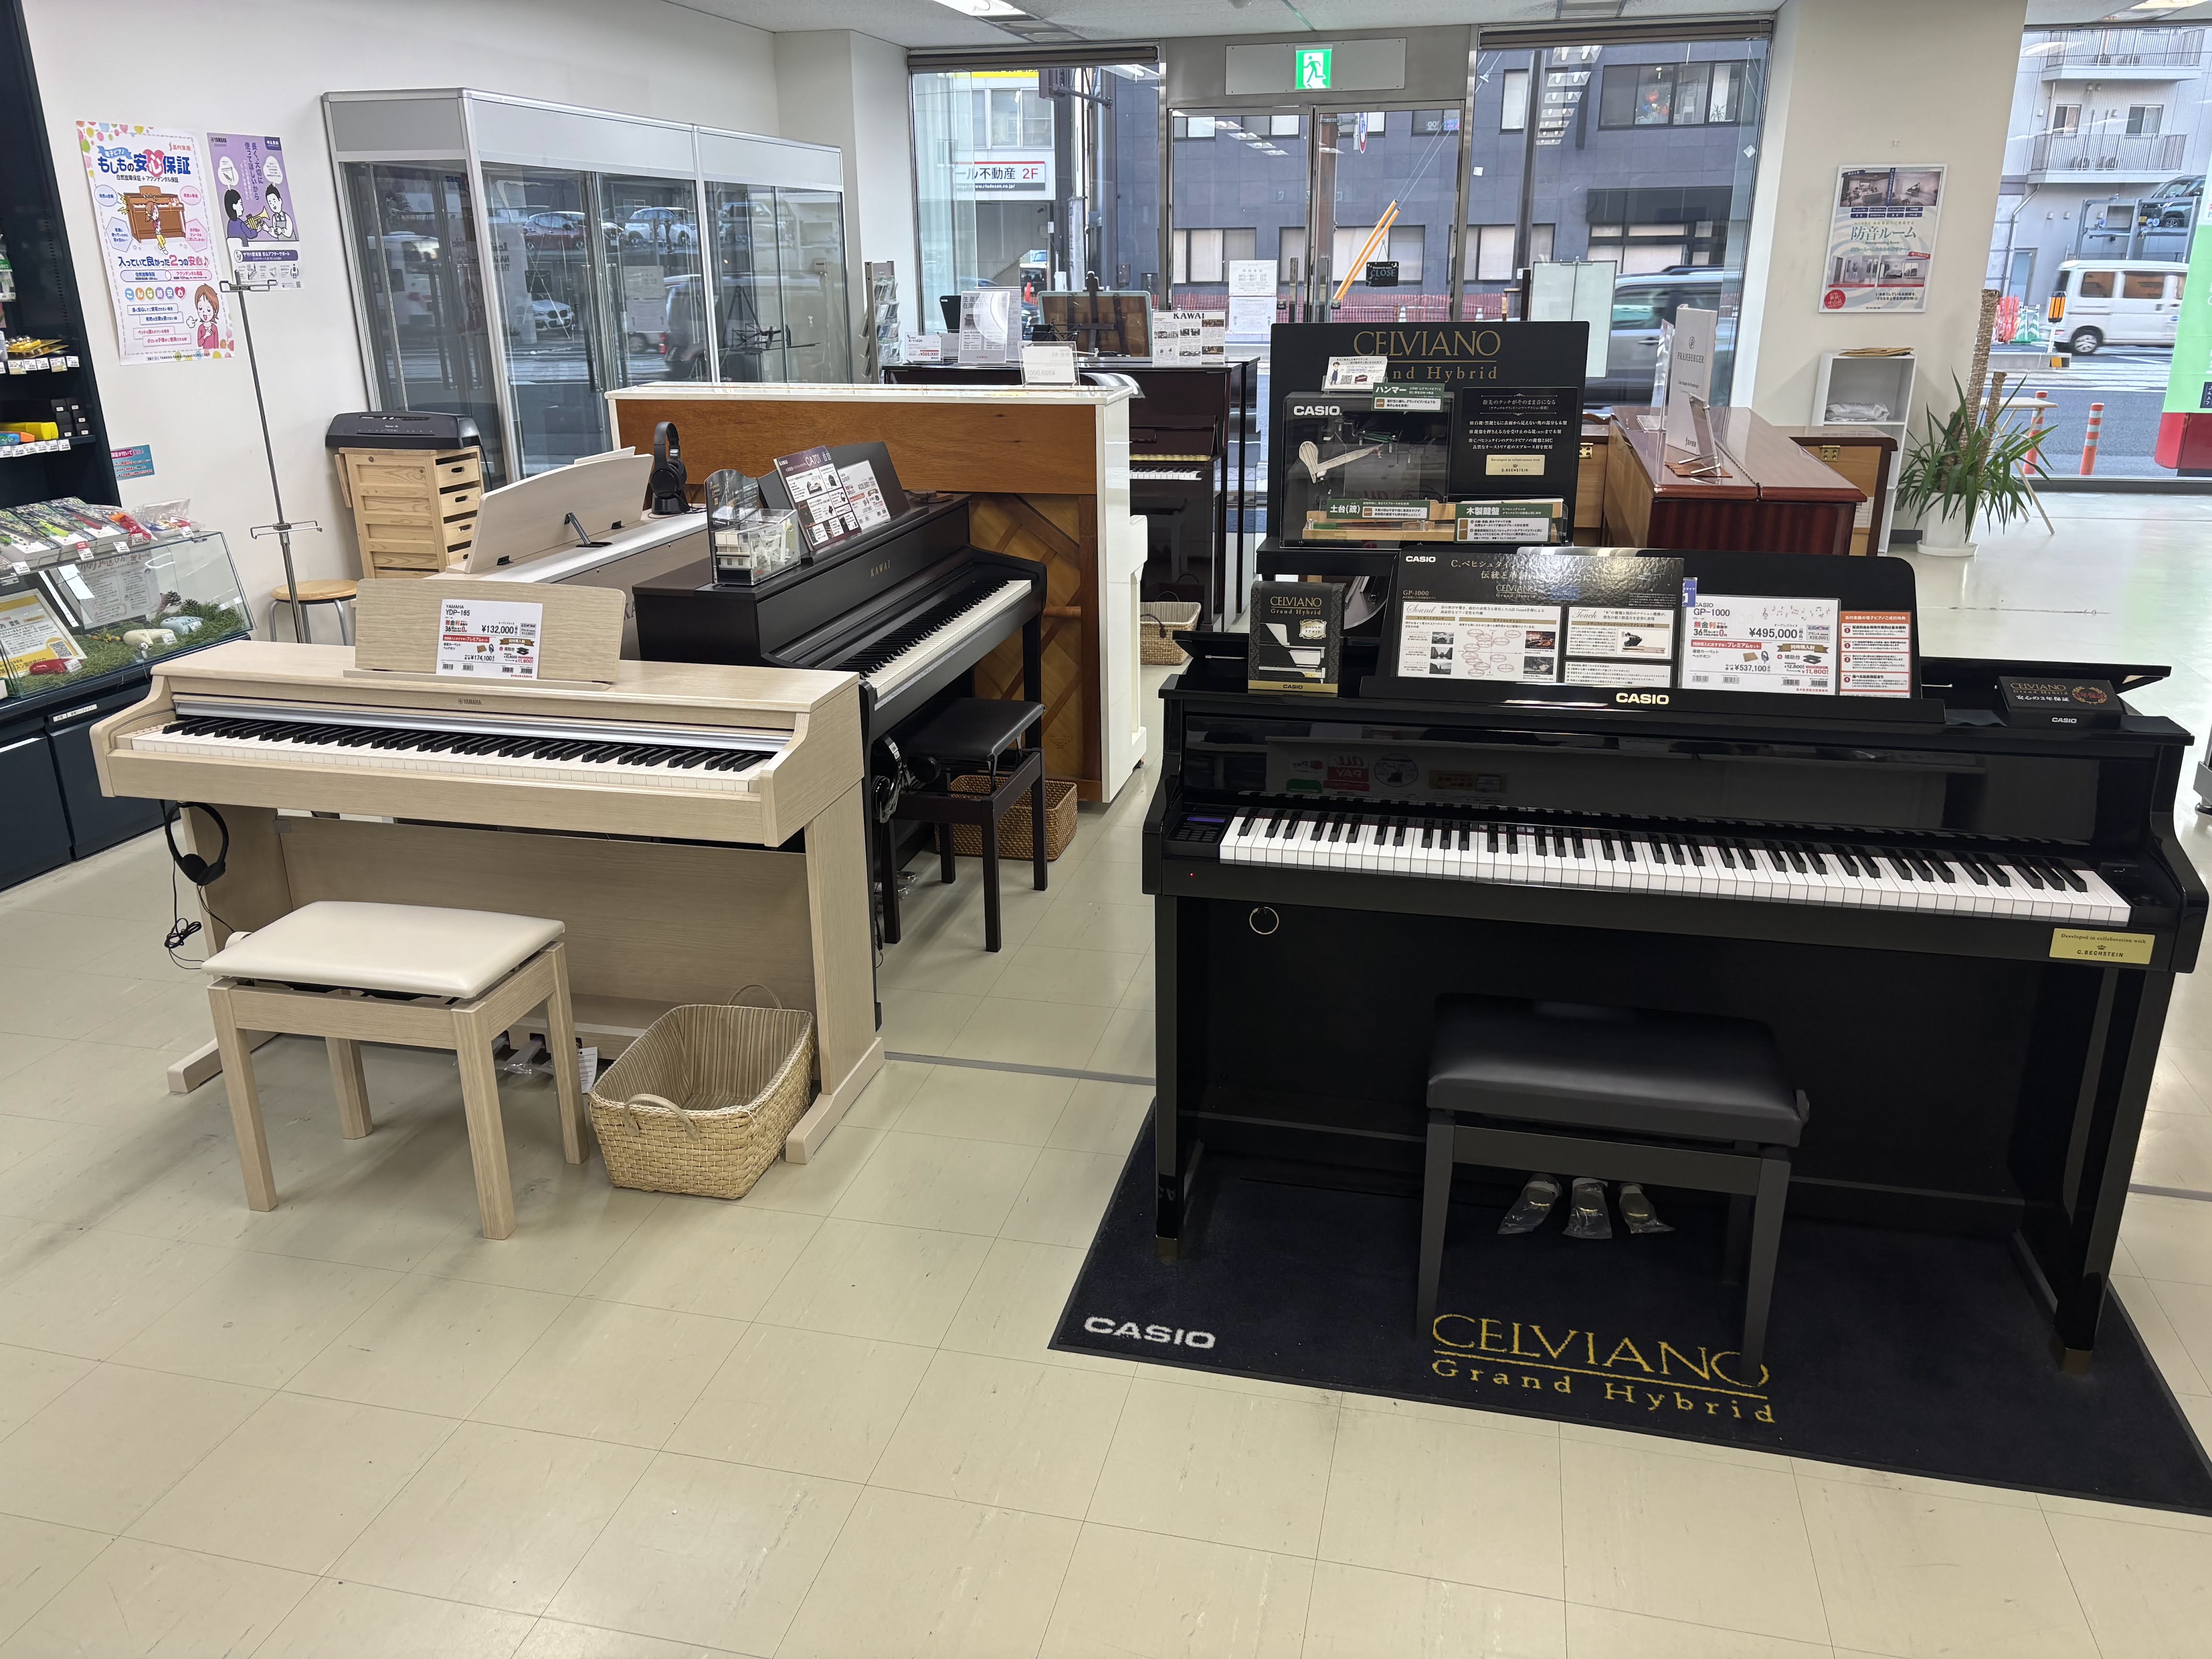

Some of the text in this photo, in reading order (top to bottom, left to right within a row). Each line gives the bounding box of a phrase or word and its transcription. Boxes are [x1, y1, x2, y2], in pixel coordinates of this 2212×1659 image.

[98, 153, 191, 174] もしもの安心保証
[1023, 168, 1038, 180] 2F
[1851, 226, 1916, 240] 防音ルーム
[1354, 330, 1501, 357] CELVIANO
[1677, 352, 1704, 364] PRAMBERGER
[1427, 366, 1498, 382] Hybrid
[1294, 406, 1341, 416] CASIO
[805, 454, 821, 466] CA701
[1466, 507, 1500, 516] 木製鍵盤
[871, 560, 890, 577] KAWAI
[1496, 584, 1537, 593] CELVIANO
[1270, 597, 1322, 607] CELVIANO
[1407, 603, 1437, 614] Sound
[1572, 609, 1597, 619] Touch
[1693, 608, 1730, 617] GP-1000
[481, 625, 514, 635] ¥132,000
[1749, 627, 1796, 639] ¥495,000
[2010, 682, 2067, 691] CELVIANO
[1616, 693, 1669, 705] CASIO
[1083, 1315, 1217, 1350] CASIO
[1432, 1314, 1769, 1387] CELVIANO
[1432, 1359, 1776, 1423] Grand Hybrid
